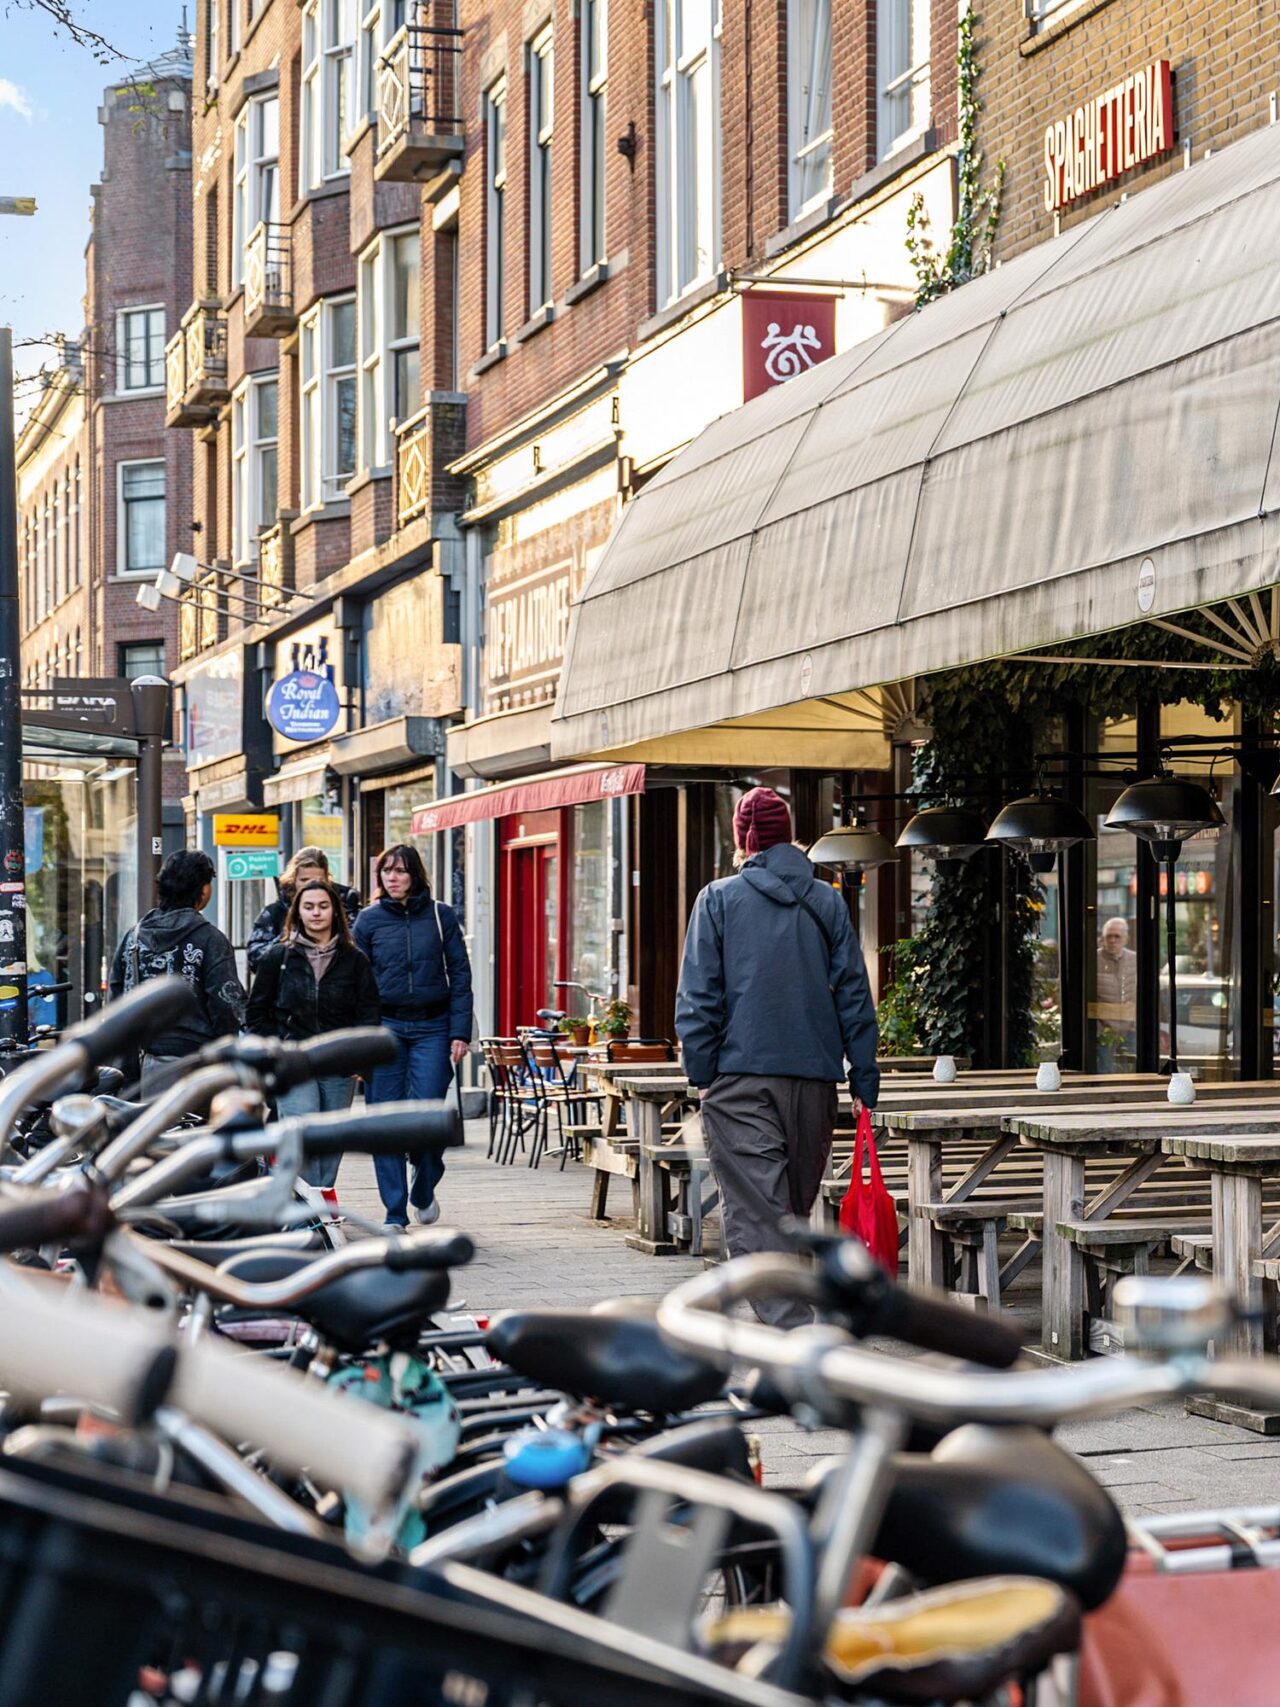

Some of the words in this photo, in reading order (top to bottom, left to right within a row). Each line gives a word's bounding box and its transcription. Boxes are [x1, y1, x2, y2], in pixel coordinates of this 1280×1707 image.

[1044, 60, 1168, 212] SPAGHETTERIA
[281, 678, 327, 707] Royal
[279, 700, 330, 720] Indian
[224, 825, 268, 834] DHL
